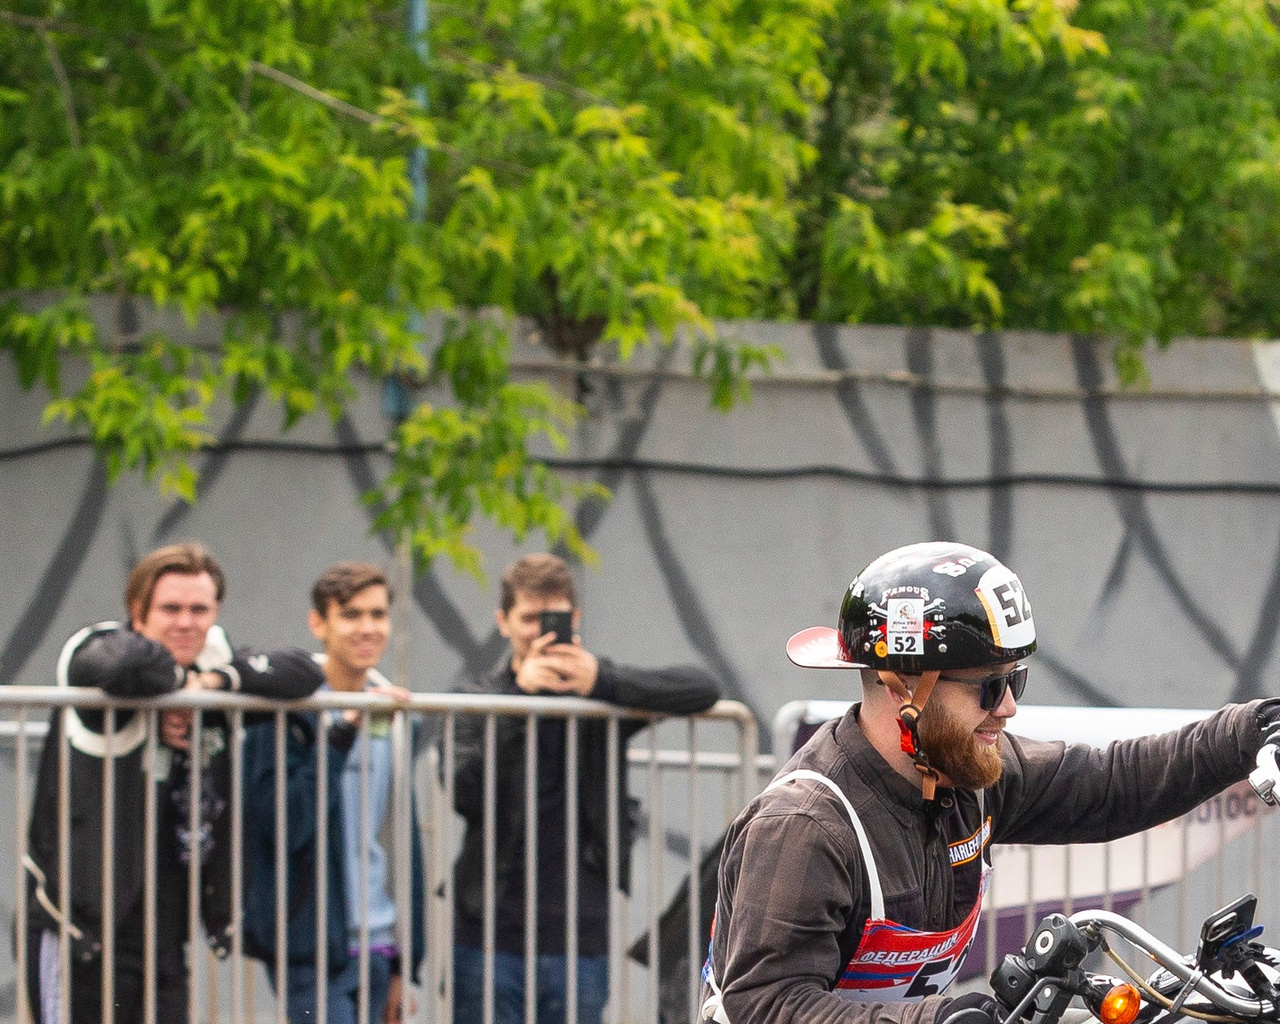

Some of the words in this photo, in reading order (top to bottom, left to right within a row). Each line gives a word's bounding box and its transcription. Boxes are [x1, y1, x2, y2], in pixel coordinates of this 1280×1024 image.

[880, 585, 930, 606] FAMOUS
[894, 636, 917, 653] 52
[860, 931, 958, 966] ФЕДЕРАЦИЯ
